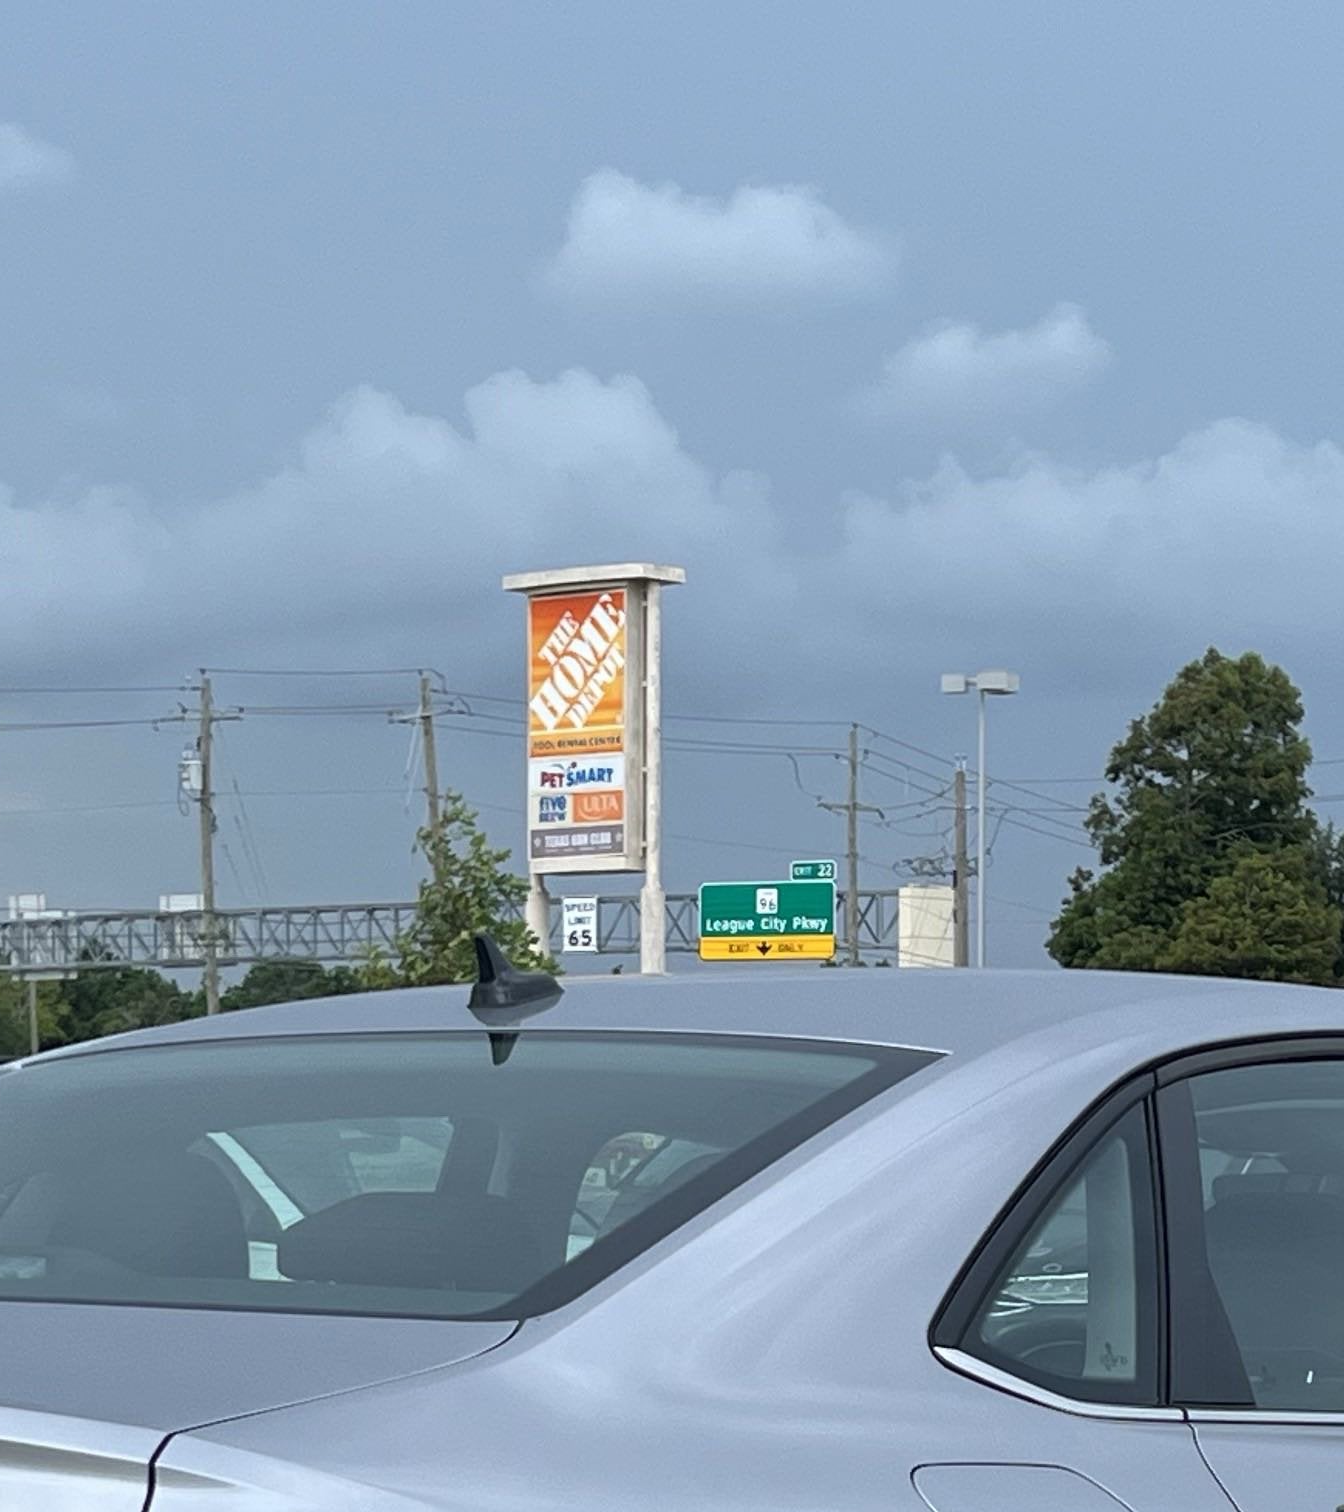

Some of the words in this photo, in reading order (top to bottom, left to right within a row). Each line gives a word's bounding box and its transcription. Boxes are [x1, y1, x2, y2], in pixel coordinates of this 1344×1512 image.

[537, 610, 580, 665] THE
[529, 594, 626, 731] HOME
[564, 641, 625, 730] DEPOT
[579, 794, 620, 818] ULTA
[817, 864, 832, 877] 22
[759, 898, 776, 911] 96
[705, 918, 755, 934] League
[760, 916, 787, 933] City
[792, 916, 828, 933] Pkwy
[568, 929, 592, 947] 65
